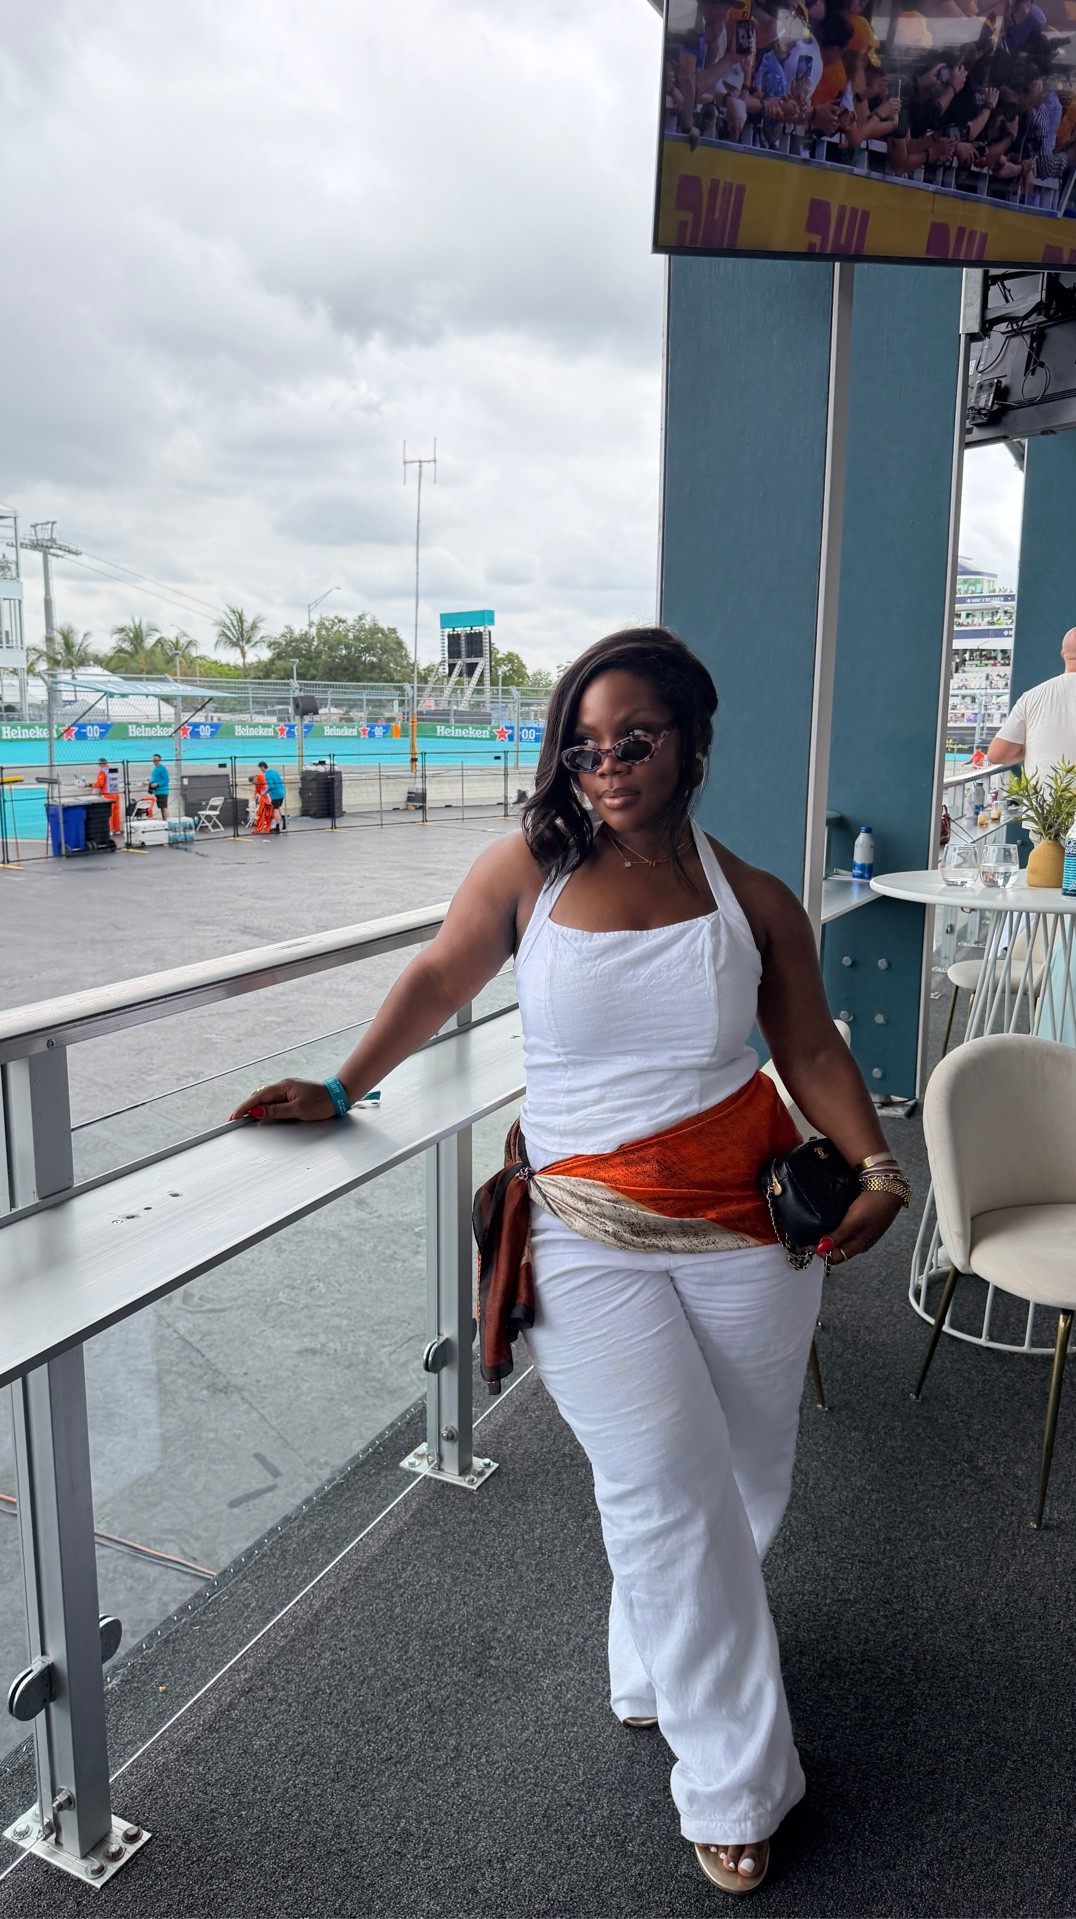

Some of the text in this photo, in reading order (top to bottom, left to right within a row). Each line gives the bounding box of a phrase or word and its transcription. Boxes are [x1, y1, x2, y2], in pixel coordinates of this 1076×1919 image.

[1, 725, 57, 739] Heineke
[234, 724, 275, 737] Heineken
[323, 725, 359, 737] Heineken
[436, 725, 491, 739] Heineken
